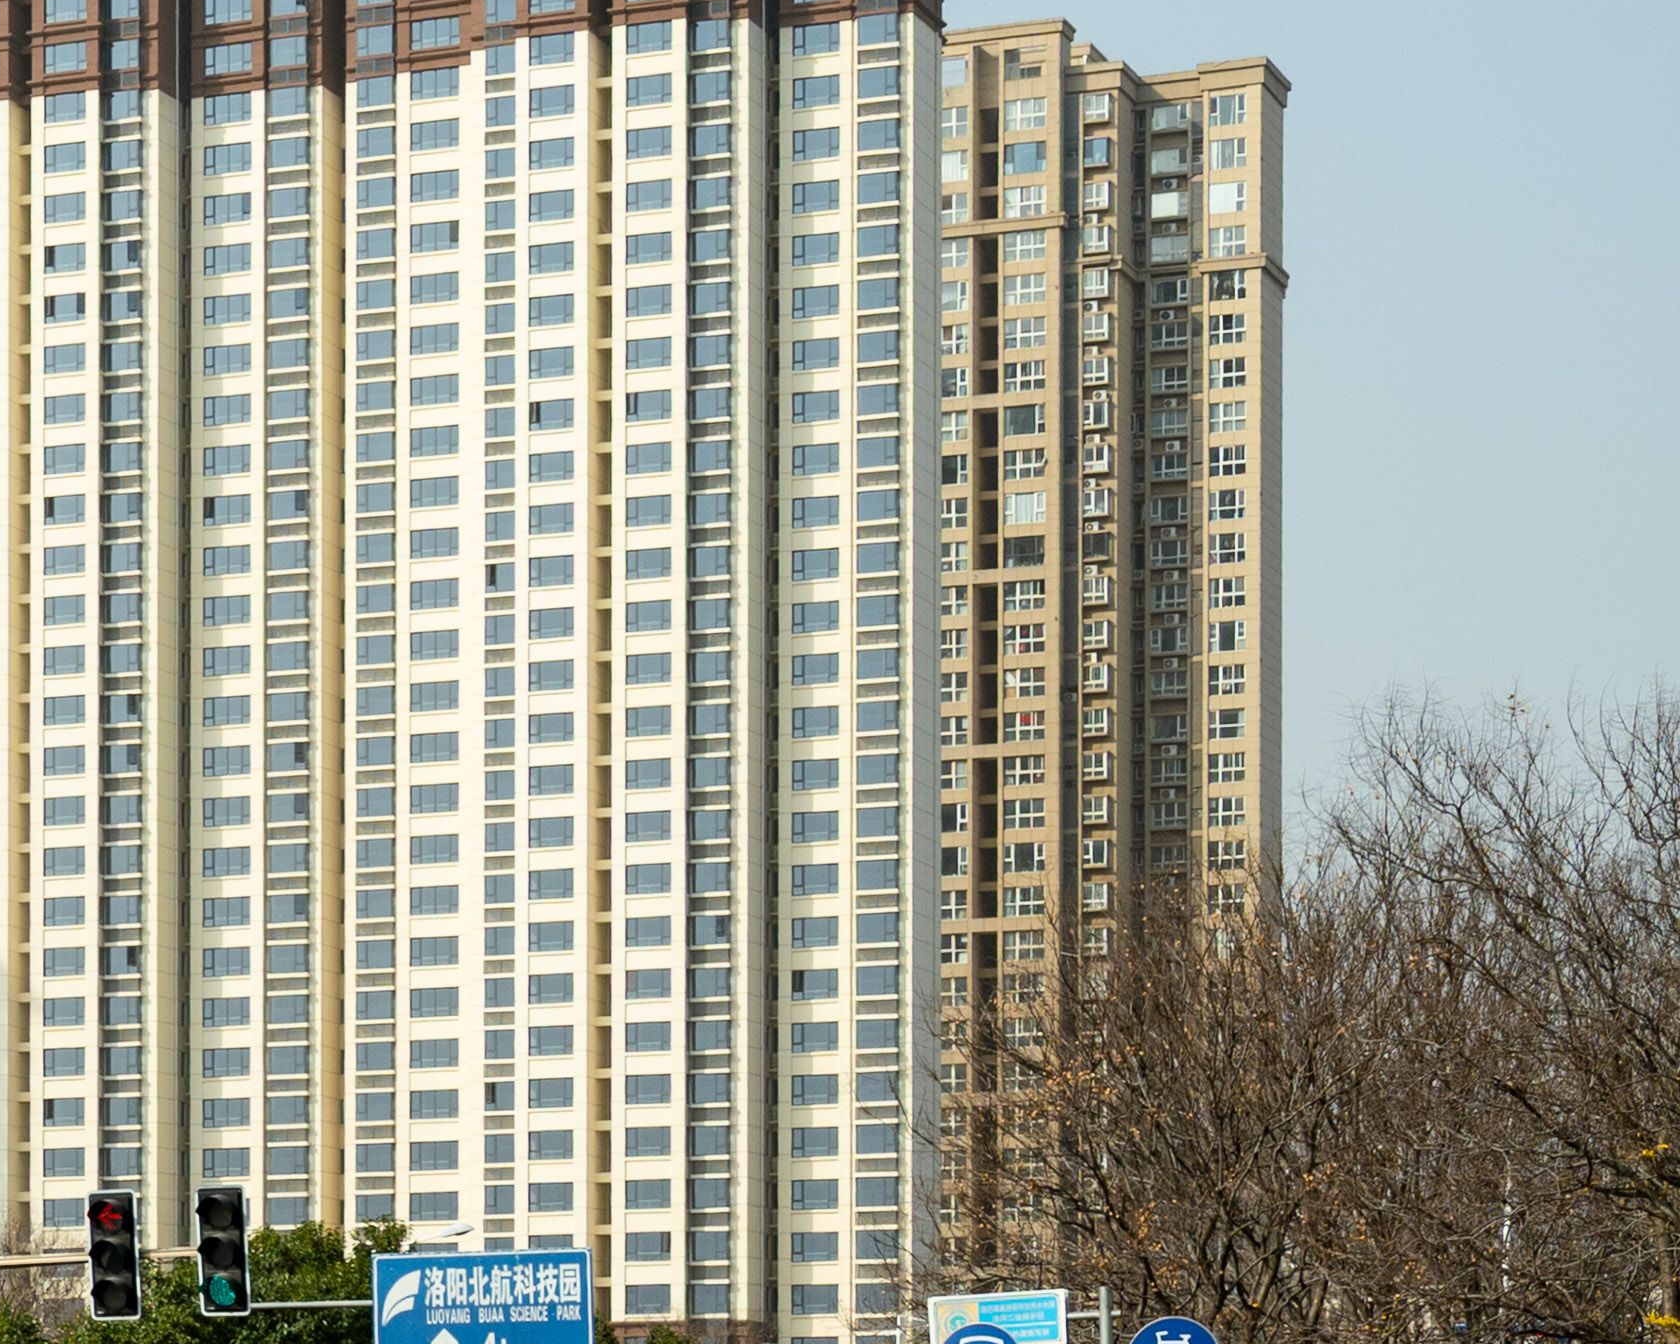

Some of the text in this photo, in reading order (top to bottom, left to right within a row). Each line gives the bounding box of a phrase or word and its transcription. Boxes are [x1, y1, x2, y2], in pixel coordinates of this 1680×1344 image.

[424, 1263, 582, 1308] 洛阳北航科技园
[426, 1305, 582, 1325] LUOYANG BUAA SCIENCE PARK
